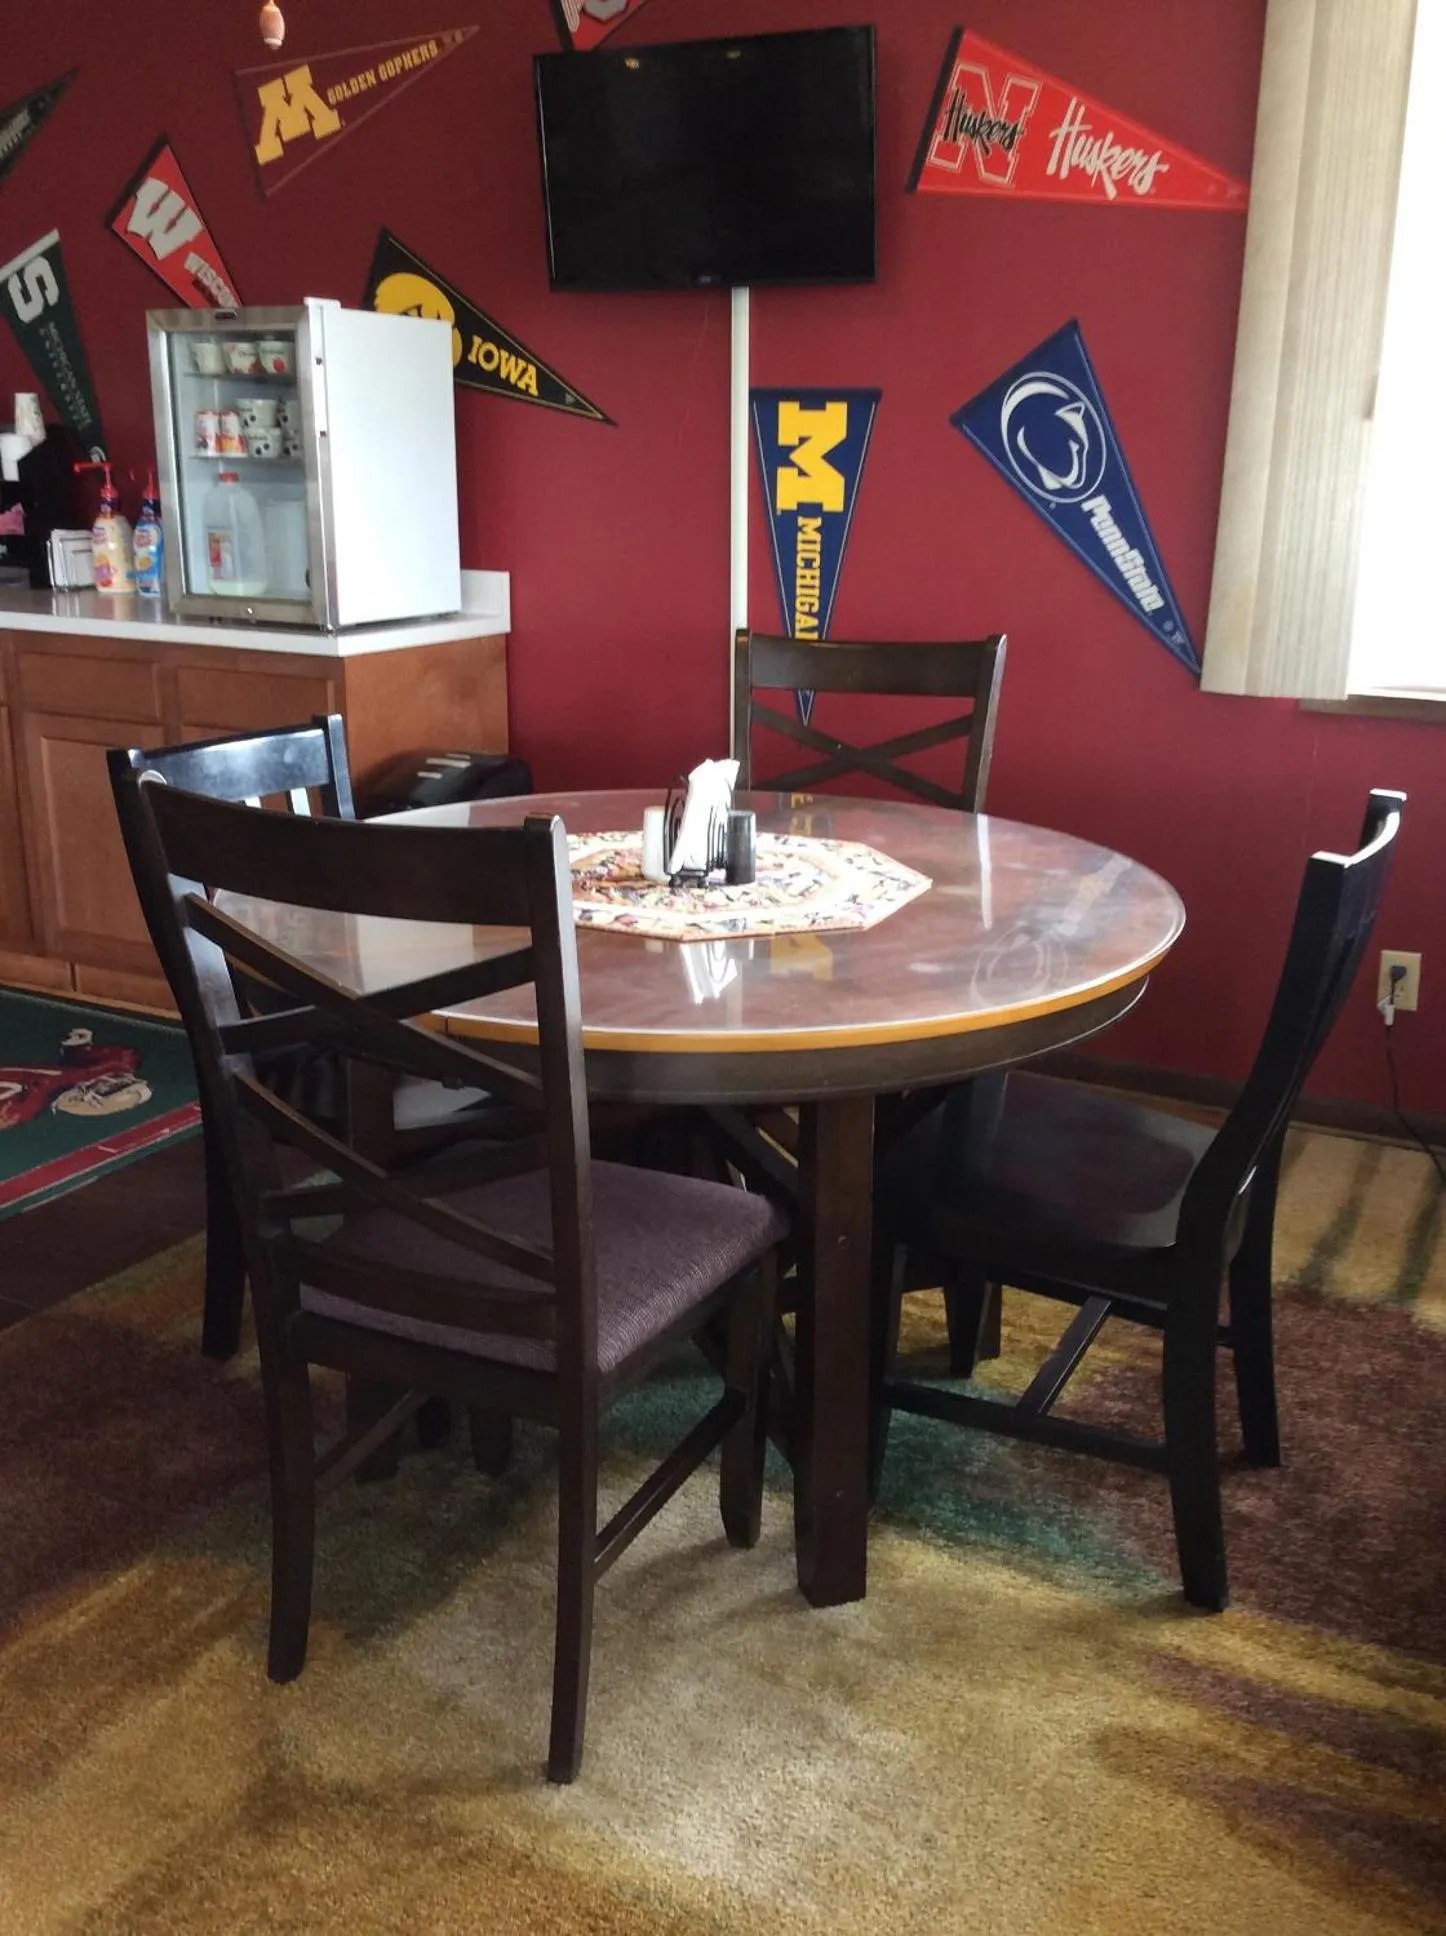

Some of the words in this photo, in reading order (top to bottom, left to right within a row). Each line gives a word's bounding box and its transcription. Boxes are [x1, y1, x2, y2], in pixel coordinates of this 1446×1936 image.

[255, 64, 341, 165] M
[326, 68, 377, 106] GOLDEN
[378, 39, 439, 82] GOPHERS
[928, 62, 1042, 190] N
[942, 87, 1025, 157] Huskers
[1046, 96, 1170, 201] Huskers
[127, 176, 204, 261] W
[7, 255, 60, 324] S
[467, 334, 540, 397] IOWA
[776, 401, 848, 512] M
